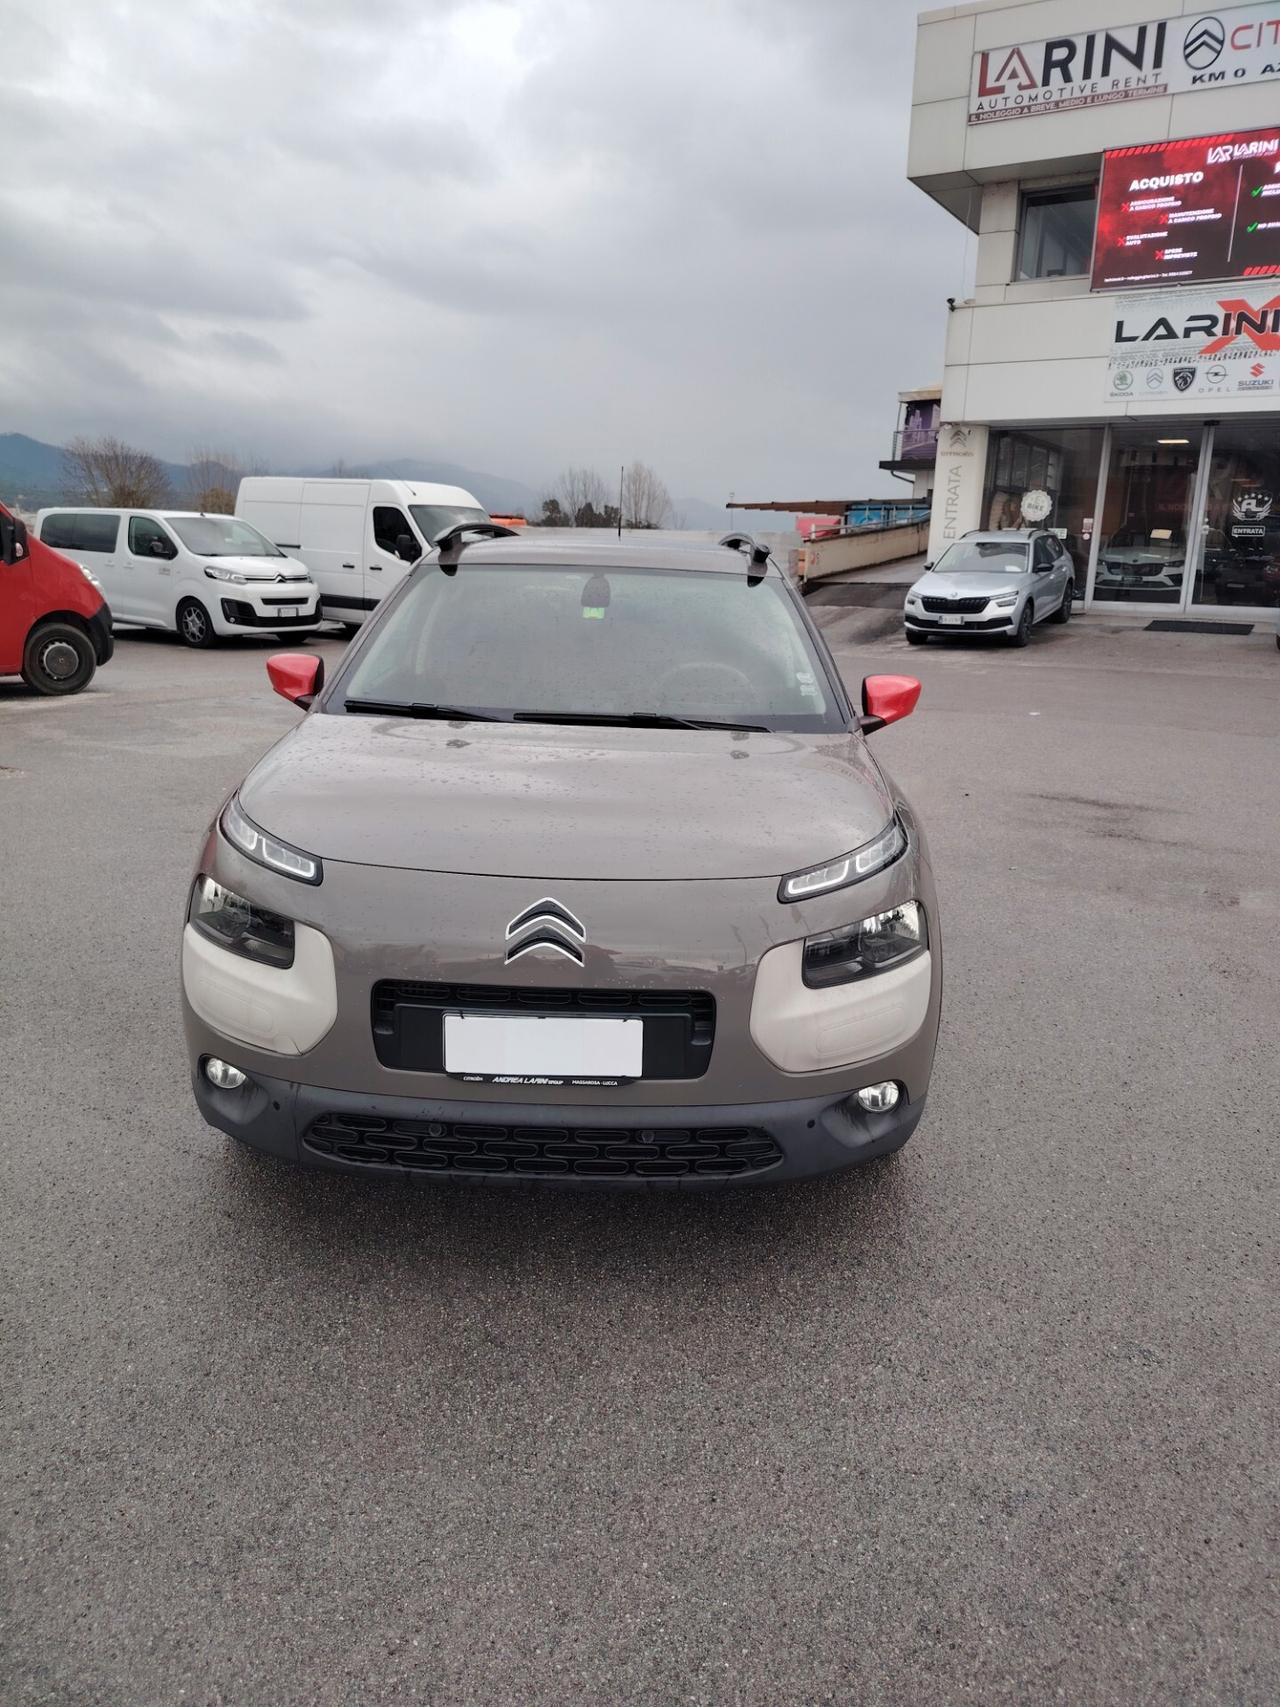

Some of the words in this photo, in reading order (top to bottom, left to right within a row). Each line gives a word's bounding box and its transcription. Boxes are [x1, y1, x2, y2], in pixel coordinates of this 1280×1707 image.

[978, 22, 1167, 97] LARINI
[1191, 70, 1226, 85] KM
[976, 82, 1099, 111] AUTOMOTIVE
[1111, 72, 1161, 90] RENT
[979, 107, 1021, 120] NOLEGGIO
[1058, 97, 1085, 107] MEDIO
[1094, 92, 1125, 102] LUNGO
[1127, 85, 1165, 97] TERMINE
[1129, 171, 1204, 191] ACQUISTO
[1238, 379, 1274, 387] SUZUKI
[943, 465, 962, 540] ENTRATA
[492, 1076, 523, 1084] ANDREA
